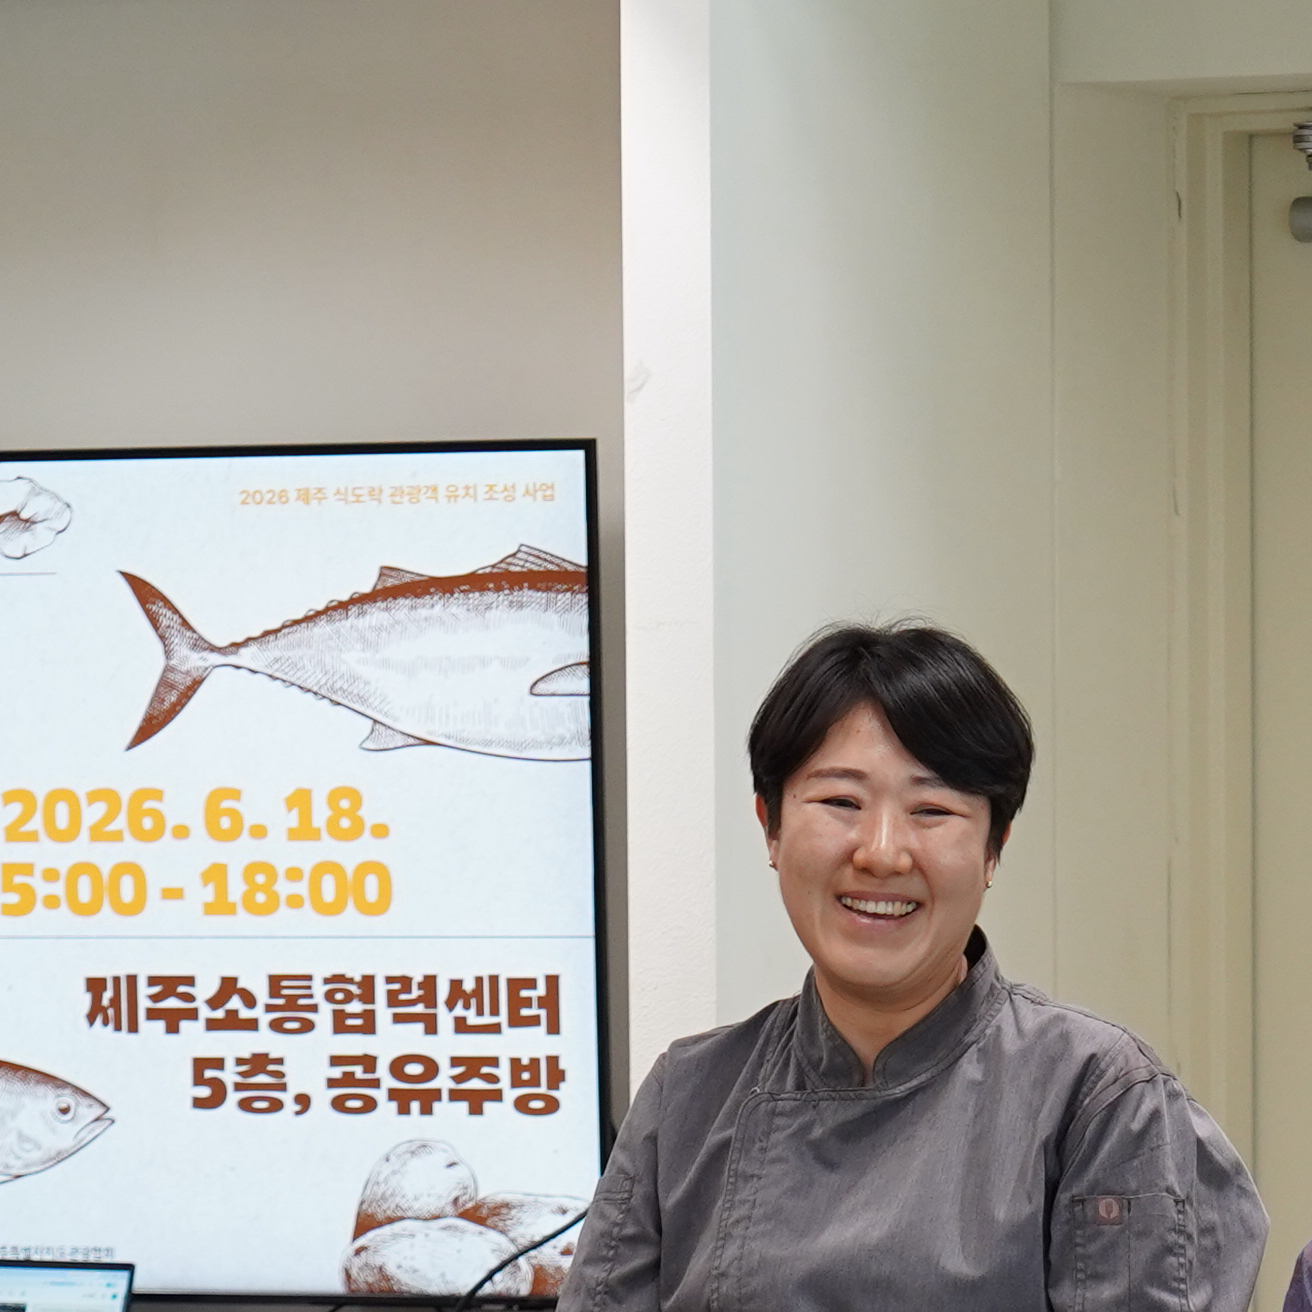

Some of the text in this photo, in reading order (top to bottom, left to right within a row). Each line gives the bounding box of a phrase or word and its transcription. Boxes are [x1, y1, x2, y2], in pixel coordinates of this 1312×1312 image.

[239, 482, 556, 506] 2026 제주 식도락 관광객 유치 조성 사업
[85, 974, 561, 1035] 제주소통협력센터
[327, 1053, 566, 1117] 공유주방
